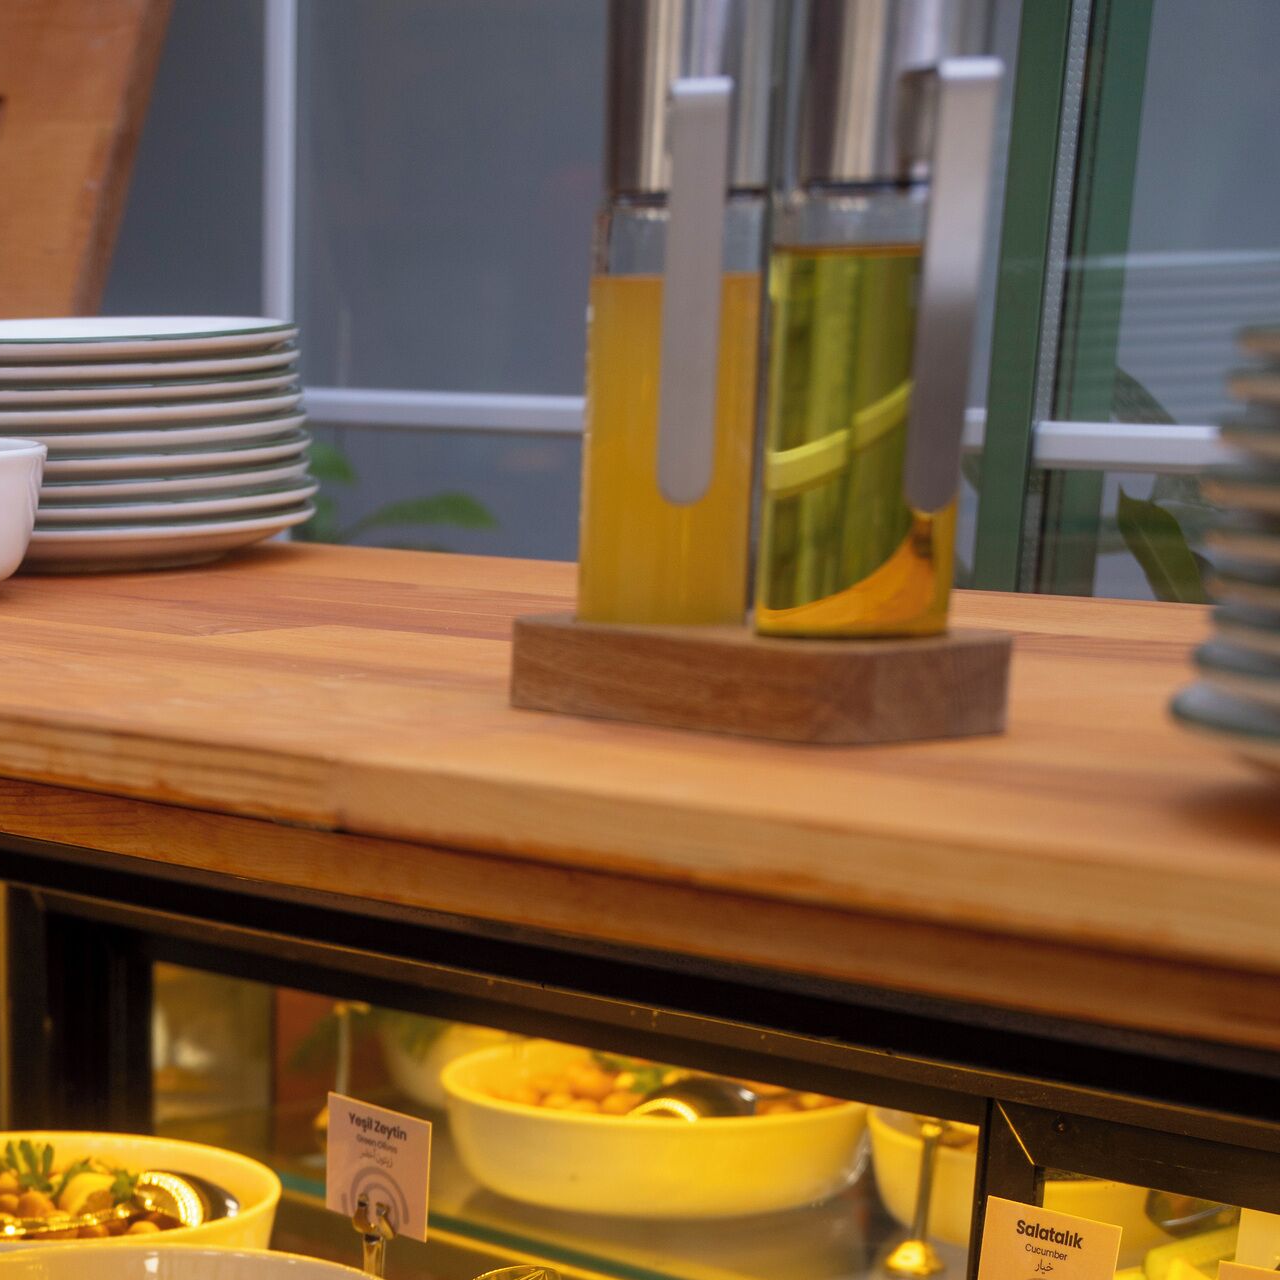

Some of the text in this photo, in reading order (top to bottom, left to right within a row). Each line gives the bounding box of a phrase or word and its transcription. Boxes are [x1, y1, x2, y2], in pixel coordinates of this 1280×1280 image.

[348, 1112, 408, 1141] Yeşil Zeytin
[1016, 1219, 1084, 1249] Salatalık
[1025, 1243, 1068, 1261] Cucumber
[1034, 1259, 1054, 1275] خيار
